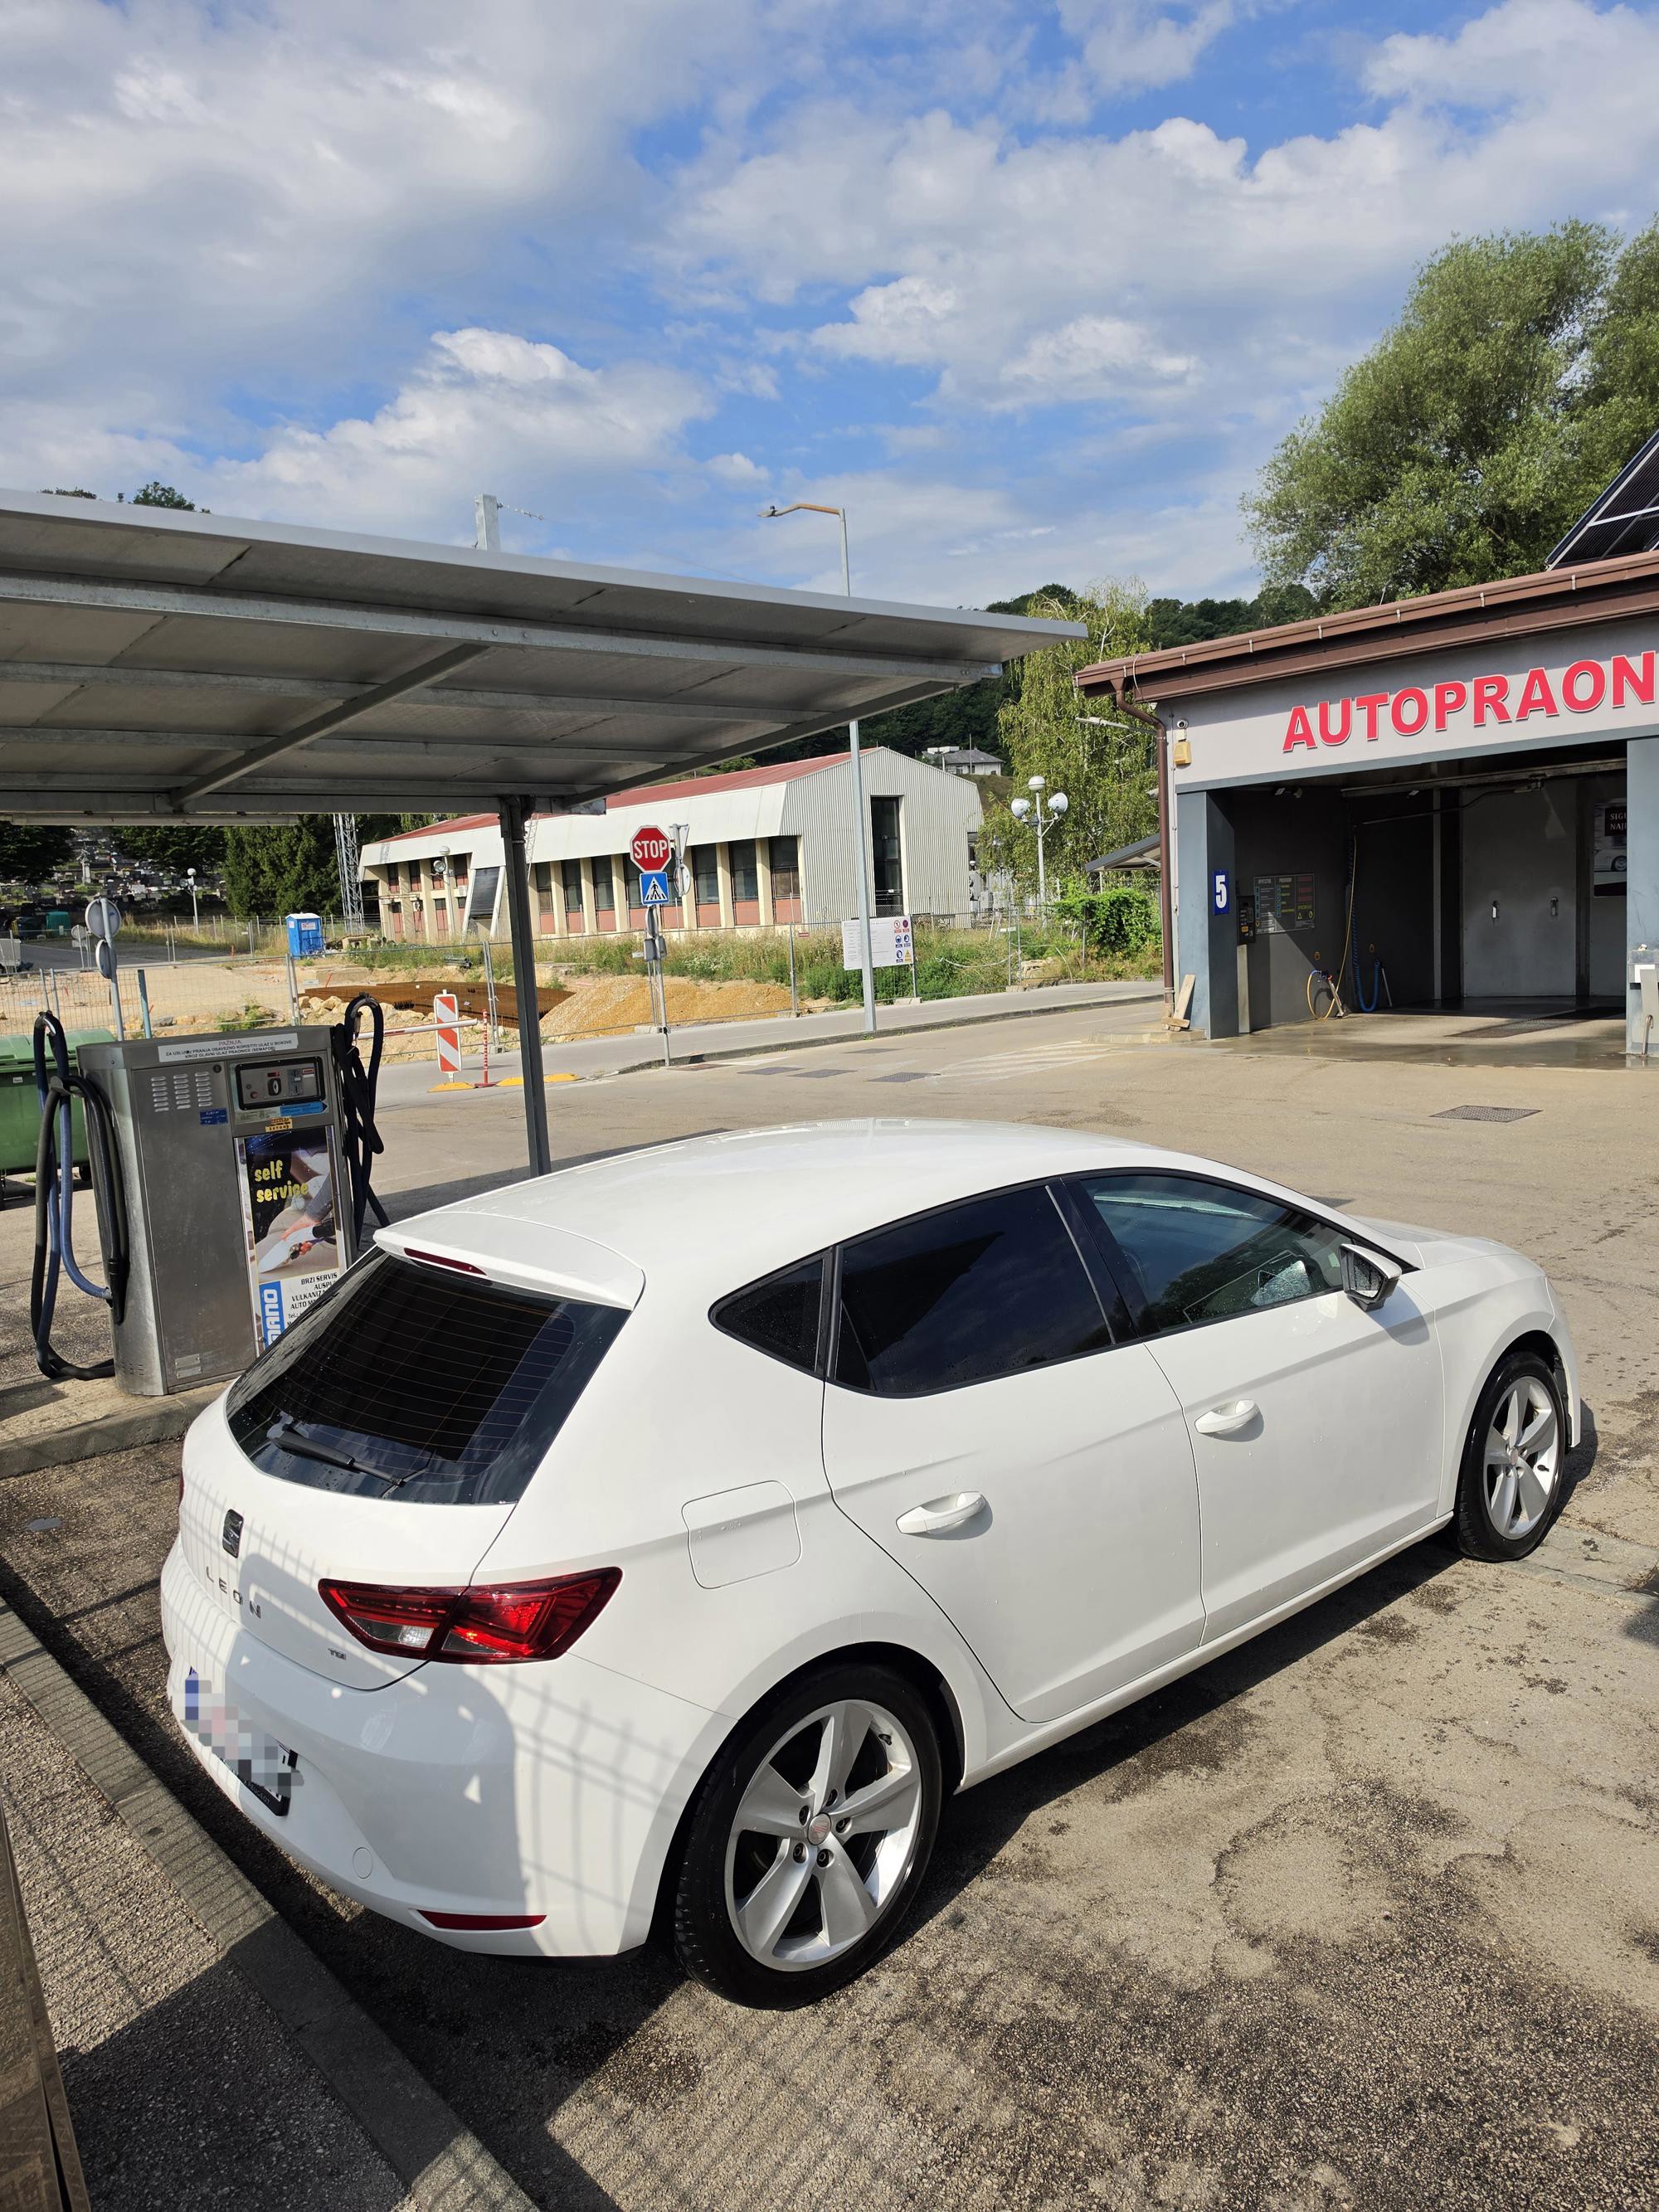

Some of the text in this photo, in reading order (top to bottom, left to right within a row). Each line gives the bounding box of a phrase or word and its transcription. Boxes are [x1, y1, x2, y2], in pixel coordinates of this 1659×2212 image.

[1282, 650, 1656, 752] AUTOPRAON
[634, 839, 667, 859] STOP
[1215, 874, 1228, 909] 5
[255, 1159, 283, 1182] self
[256, 1180, 309, 1203] service
[316, 1272, 338, 1281] SERVIS
[290, 1300, 307, 1310] AUTO
[207, 1566, 260, 1618] LEON
